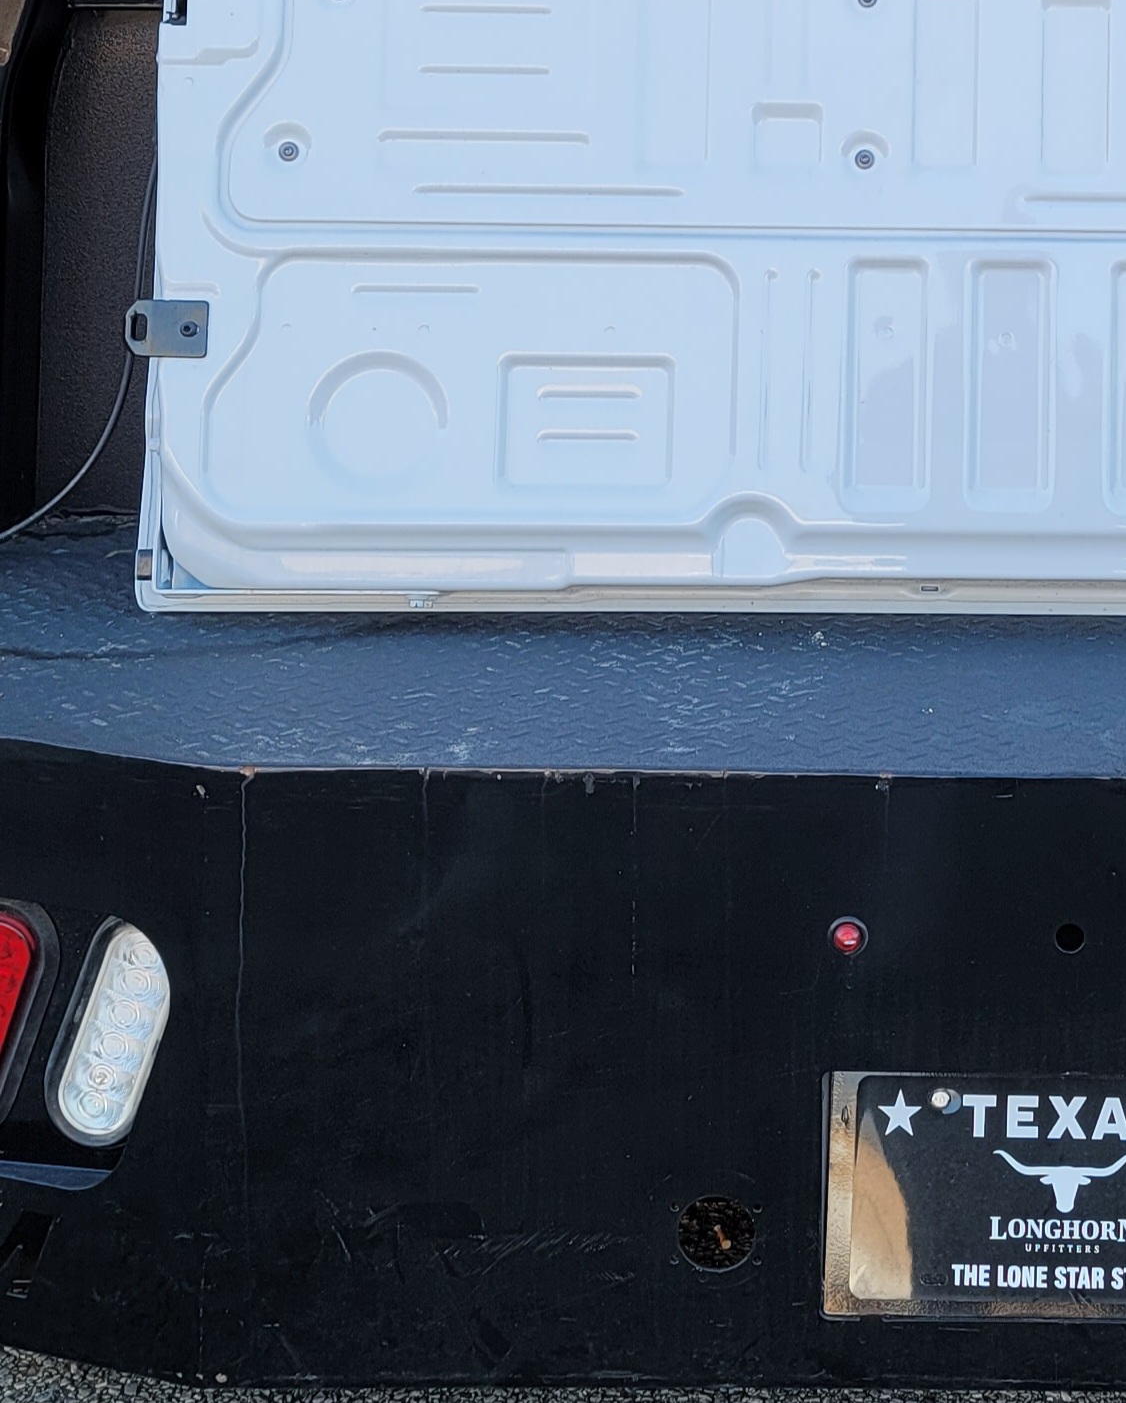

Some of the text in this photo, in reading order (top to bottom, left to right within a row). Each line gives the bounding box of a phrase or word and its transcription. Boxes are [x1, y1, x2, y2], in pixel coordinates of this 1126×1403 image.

[1025, 1243, 1101, 1255] UPFITTERS
[951, 1263, 991, 1288] THE
[997, 1265, 1049, 1289] LONE
[1054, 1266, 1105, 1290] STAR
